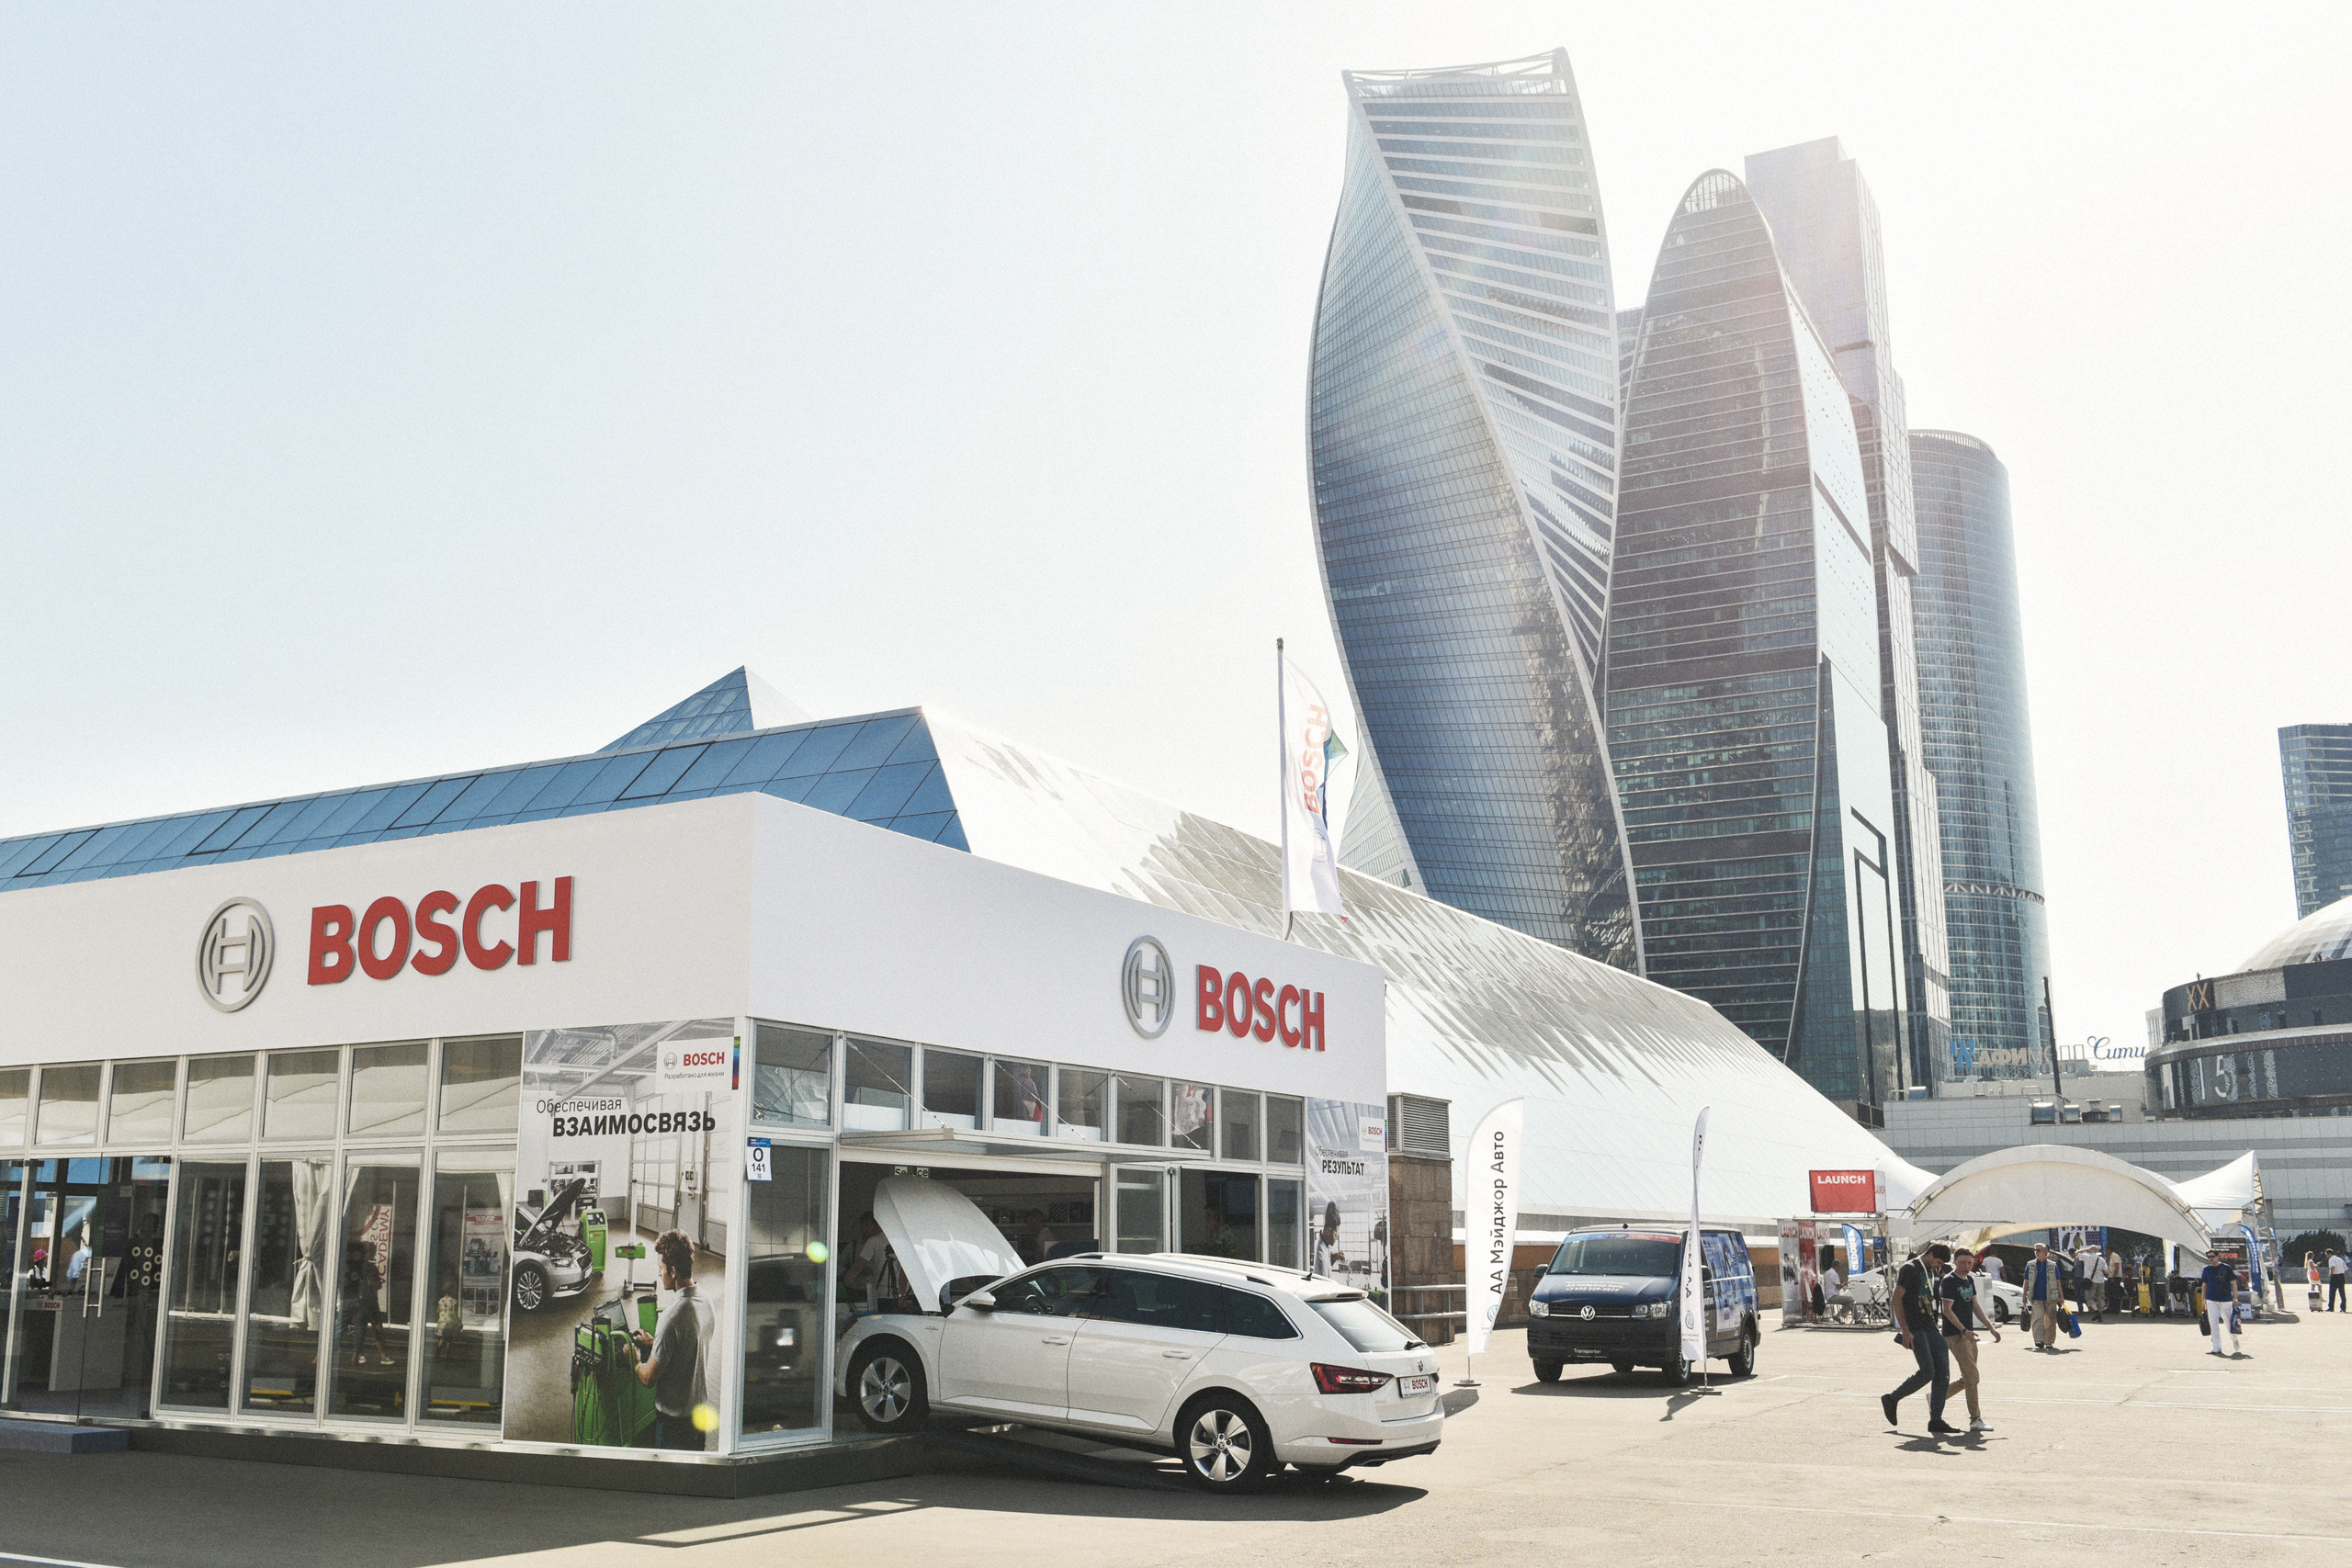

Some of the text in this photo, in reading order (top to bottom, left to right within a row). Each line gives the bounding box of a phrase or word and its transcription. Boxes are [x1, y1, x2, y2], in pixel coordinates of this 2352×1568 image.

[1301, 704, 1329, 815] BOSCH
[307, 875, 574, 986] BOSCH
[1195, 964, 1325, 1052] BOSCH
[683, 1051, 725, 1066] BOSCH
[537, 1099, 622, 1114] Обеспечивая
[552, 1111, 716, 1137] ВЗАИМОСВЯЗЬ
[1368, 1126, 1383, 1135] BOSCH
[1315, 1145, 1349, 1158] Обеспечивая
[1490, 1131, 1505, 1173] Авто
[751, 1163, 765, 1173] 141
[1322, 1159, 1365, 1176] РЕЗУЛЬТАТ
[1817, 1175, 1866, 1184] LAUNCH
[1490, 1179, 1508, 1264] Мэйджор
[1411, 1378, 1429, 1390] BOSCH
